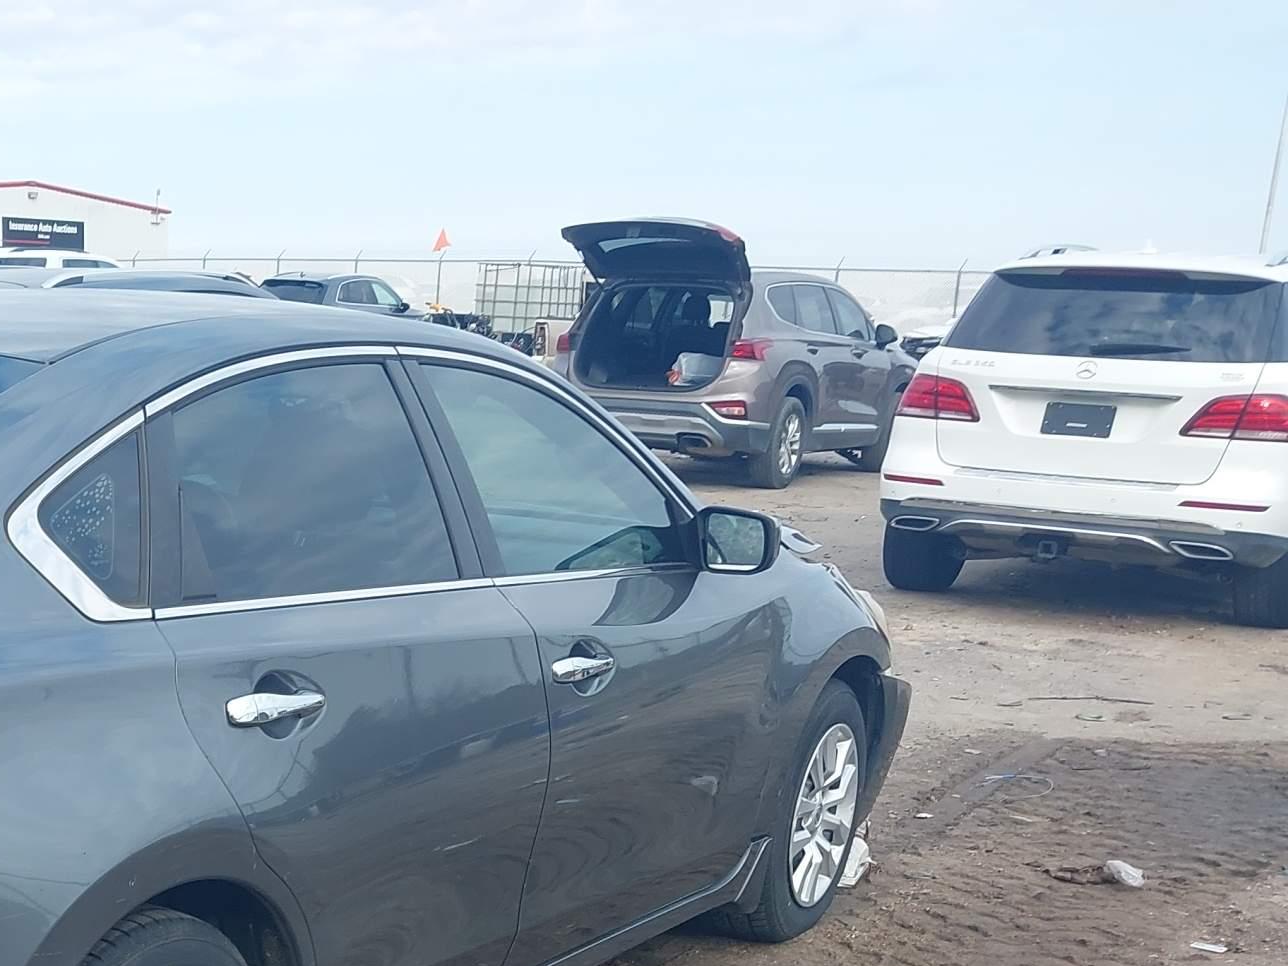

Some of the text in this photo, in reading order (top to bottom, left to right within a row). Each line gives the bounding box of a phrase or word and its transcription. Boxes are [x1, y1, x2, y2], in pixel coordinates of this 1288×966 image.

[9, 220, 38, 232] Insurance
[38, 222, 52, 232] Auto
[53, 222, 78, 234] Auctions
